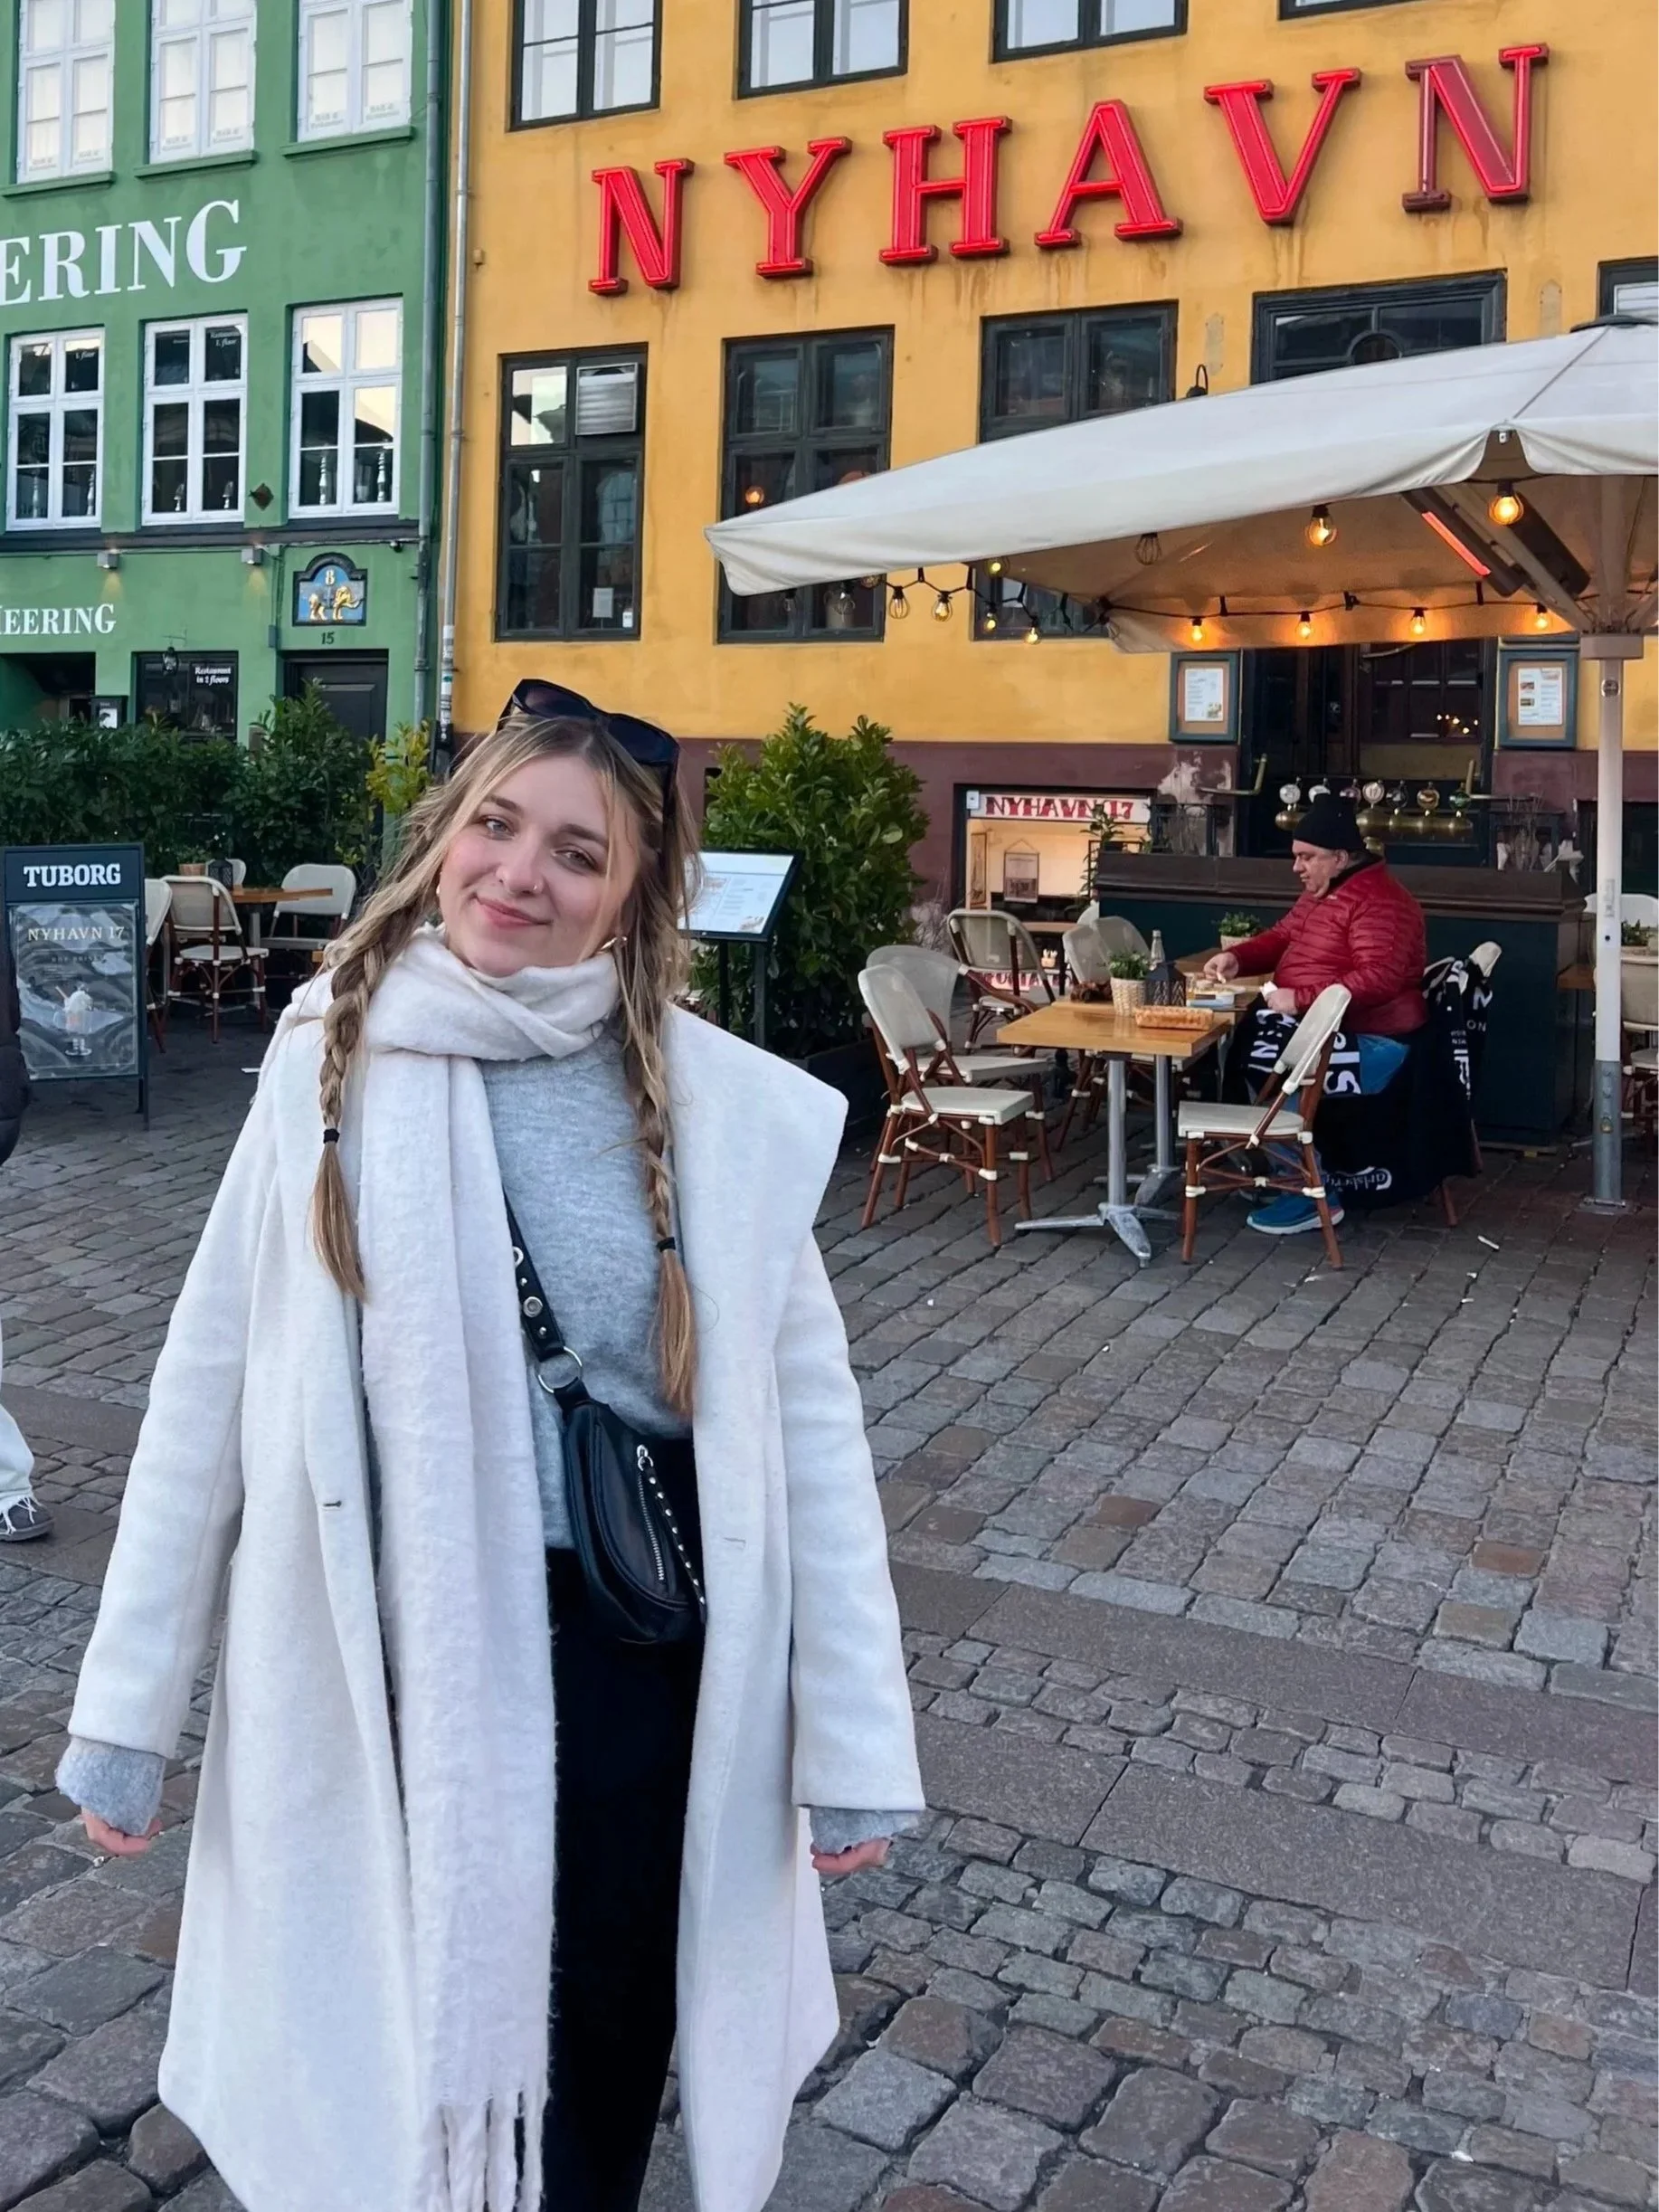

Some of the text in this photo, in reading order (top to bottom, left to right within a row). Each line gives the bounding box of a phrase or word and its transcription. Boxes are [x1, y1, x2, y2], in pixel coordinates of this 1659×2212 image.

[588, 43, 1549, 295] NYHAVN
[0, 199, 247, 306] ERING
[0, 603, 116, 635] EERING
[321, 631, 335, 645] 15
[1110, 800, 1133, 820] 17
[24, 863, 121, 888] TUBORG
[28, 926, 125, 941] NYHAVN 17
